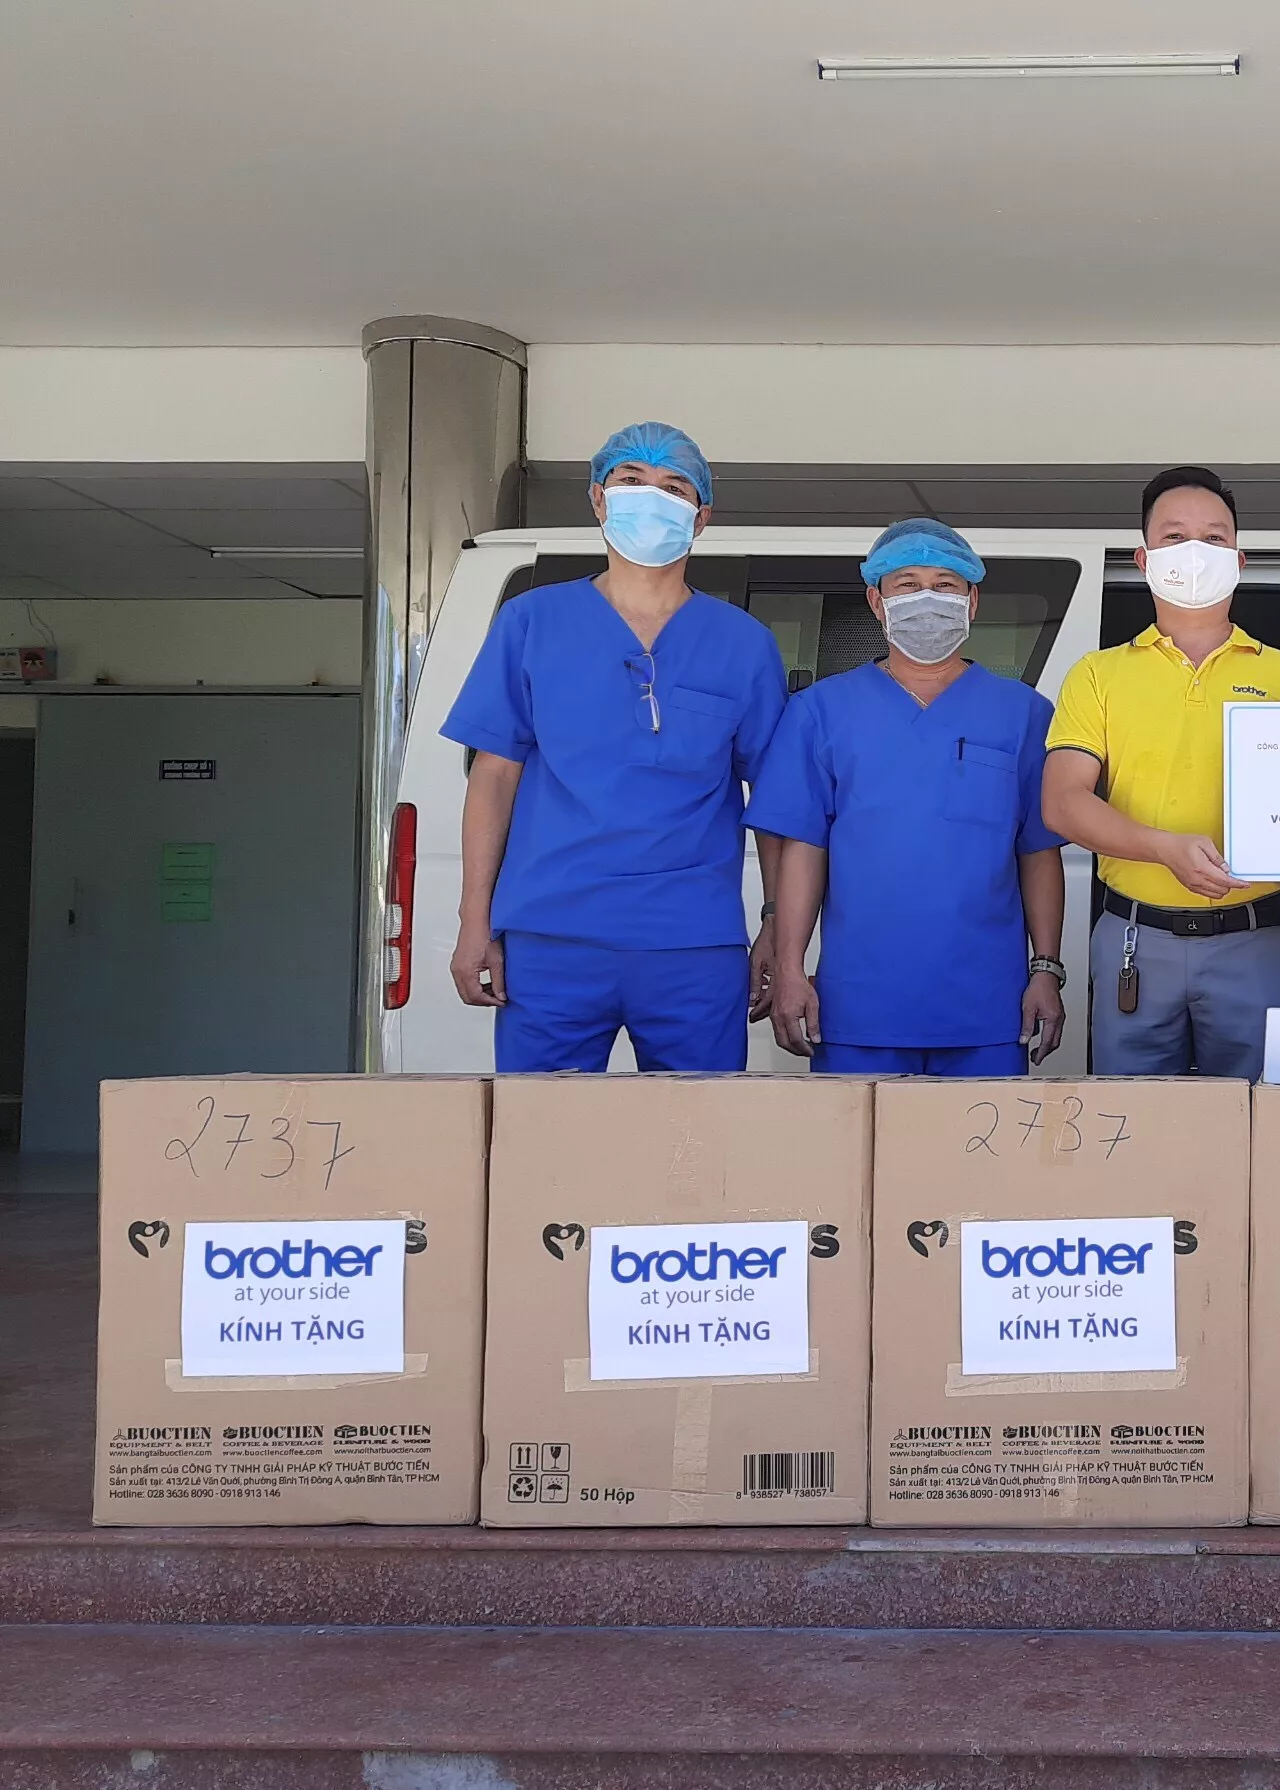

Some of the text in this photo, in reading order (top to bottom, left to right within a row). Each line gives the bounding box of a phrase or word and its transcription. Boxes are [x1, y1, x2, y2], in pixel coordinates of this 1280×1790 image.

[1232, 685, 1267, 698] brother
[965, 1096, 1131, 1160] 2737
[165, 1096, 356, 1190] 2737
[205, 1240, 382, 1279] brother
[611, 1242, 786, 1283] brother
[982, 1238, 1152, 1278] brother
[234, 1283, 350, 1305] at your side
[640, 1285, 755, 1308] at your side
[1012, 1281, 1123, 1304] at your side
[219, 1315, 365, 1346] KÍNH TẶNG
[629, 1317, 771, 1346] KÍNH TẶNG
[999, 1313, 1138, 1342] KÍNH TẶNG
[127, 1427, 212, 1440] BUOCTIEN
[238, 1426, 323, 1439] BUOCTIEN
[360, 1425, 432, 1436] BUOCTIEN
[908, 1426, 992, 1440] BUOCTIEN
[1019, 1425, 1101, 1438] BUOCTIEN
[1135, 1425, 1205, 1437] BUOCTIEN
[181, 1463, 212, 1473] CÔNG
[214, 1464, 228, 1473] TY
[231, 1464, 260, 1473] TNHH
[287, 1462, 316, 1472] PHÁP
[319, 1461, 332, 1472] KỸ
[335, 1461, 371, 1473] THUẬT
[374, 1460, 403, 1471] BƯỚC
[405, 1458, 430, 1470] TIẾN
[109, 1490, 145, 1498] Hotline:
[147, 1489, 164, 1498] 028
[166, 1489, 189, 1498] 3636
[191, 1489, 214, 1498] 8090
[220, 1489, 243, 1498] 0918
[244, 1488, 261, 1497] 913
[265, 1488, 280, 1497] 146
[580, 1488, 635, 1505] 50 Hộp
[736, 1489, 827, 1500] 8 938527 738057
[889, 1491, 924, 1500] Hotline:
[926, 1490, 943, 1499] 028
[946, 1490, 968, 1499] 3636
[970, 1490, 992, 1499] 8090
[1000, 1489, 1021, 1498] 0918
[1024, 1489, 1040, 1498] 913
[1043, 1488, 1060, 1497] 146
